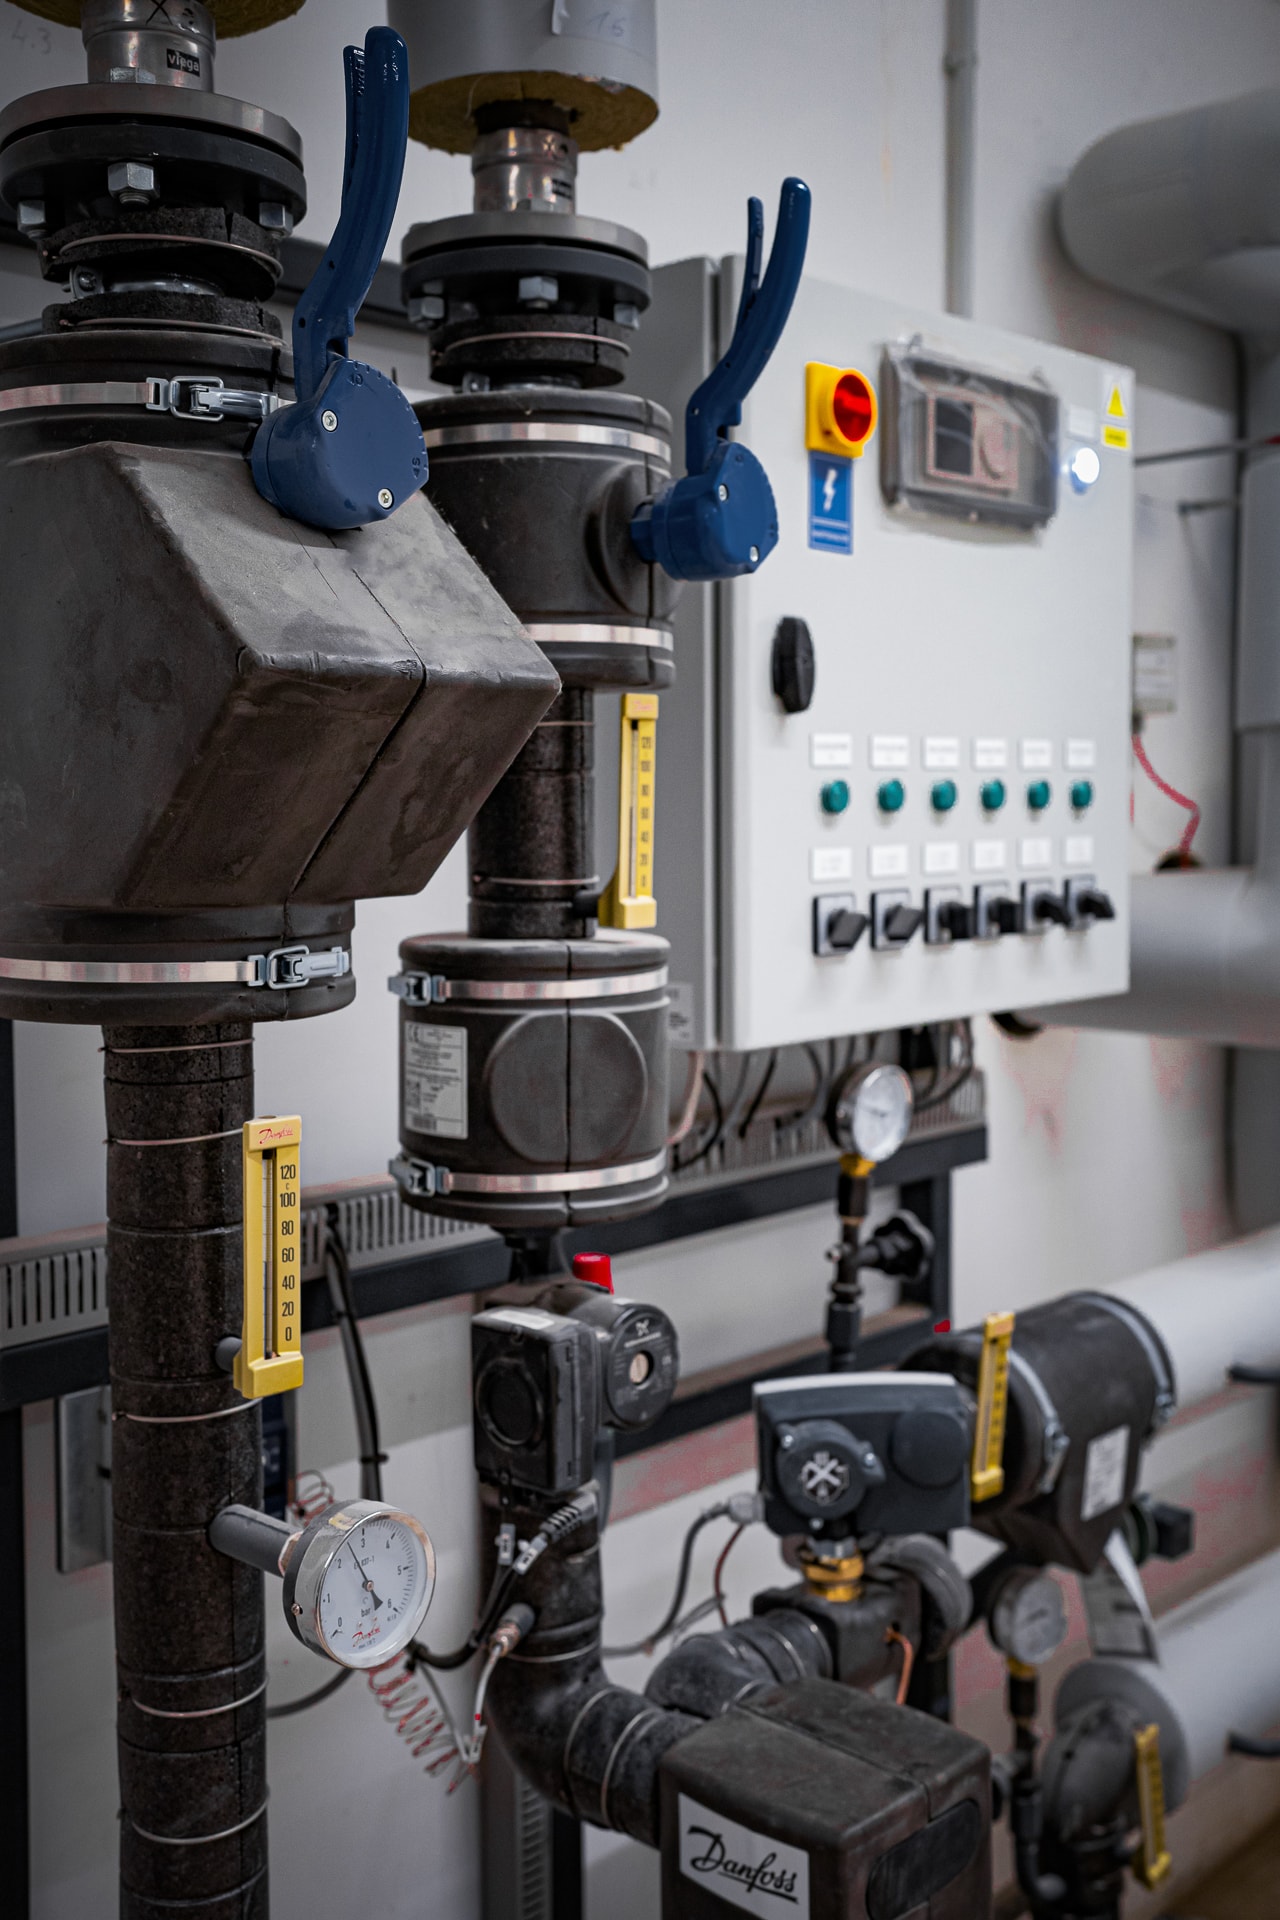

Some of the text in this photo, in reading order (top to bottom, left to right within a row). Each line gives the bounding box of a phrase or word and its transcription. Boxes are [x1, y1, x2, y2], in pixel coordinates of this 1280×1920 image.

[168, 52, 199, 71] viega
[280, 1164, 296, 1180] 120
[280, 1192, 296, 1208] 100
[281, 1220, 294, 1236] 80
[282, 1247, 295, 1263] 60
[282, 1275, 295, 1290] 40
[282, 1301, 294, 1317] 20
[285, 1326, 292, 1342] 0
[361, 1538, 366, 1548] 3
[385, 1541, 390, 1549] 4
[337, 1559, 342, 1569] 2
[398, 1565, 402, 1576] 5
[387, 1598, 392, 1608] 6
[361, 1607, 371, 1618] bar
[338, 1617, 342, 1627] 0
[688, 1826, 799, 1902] Danfoss
